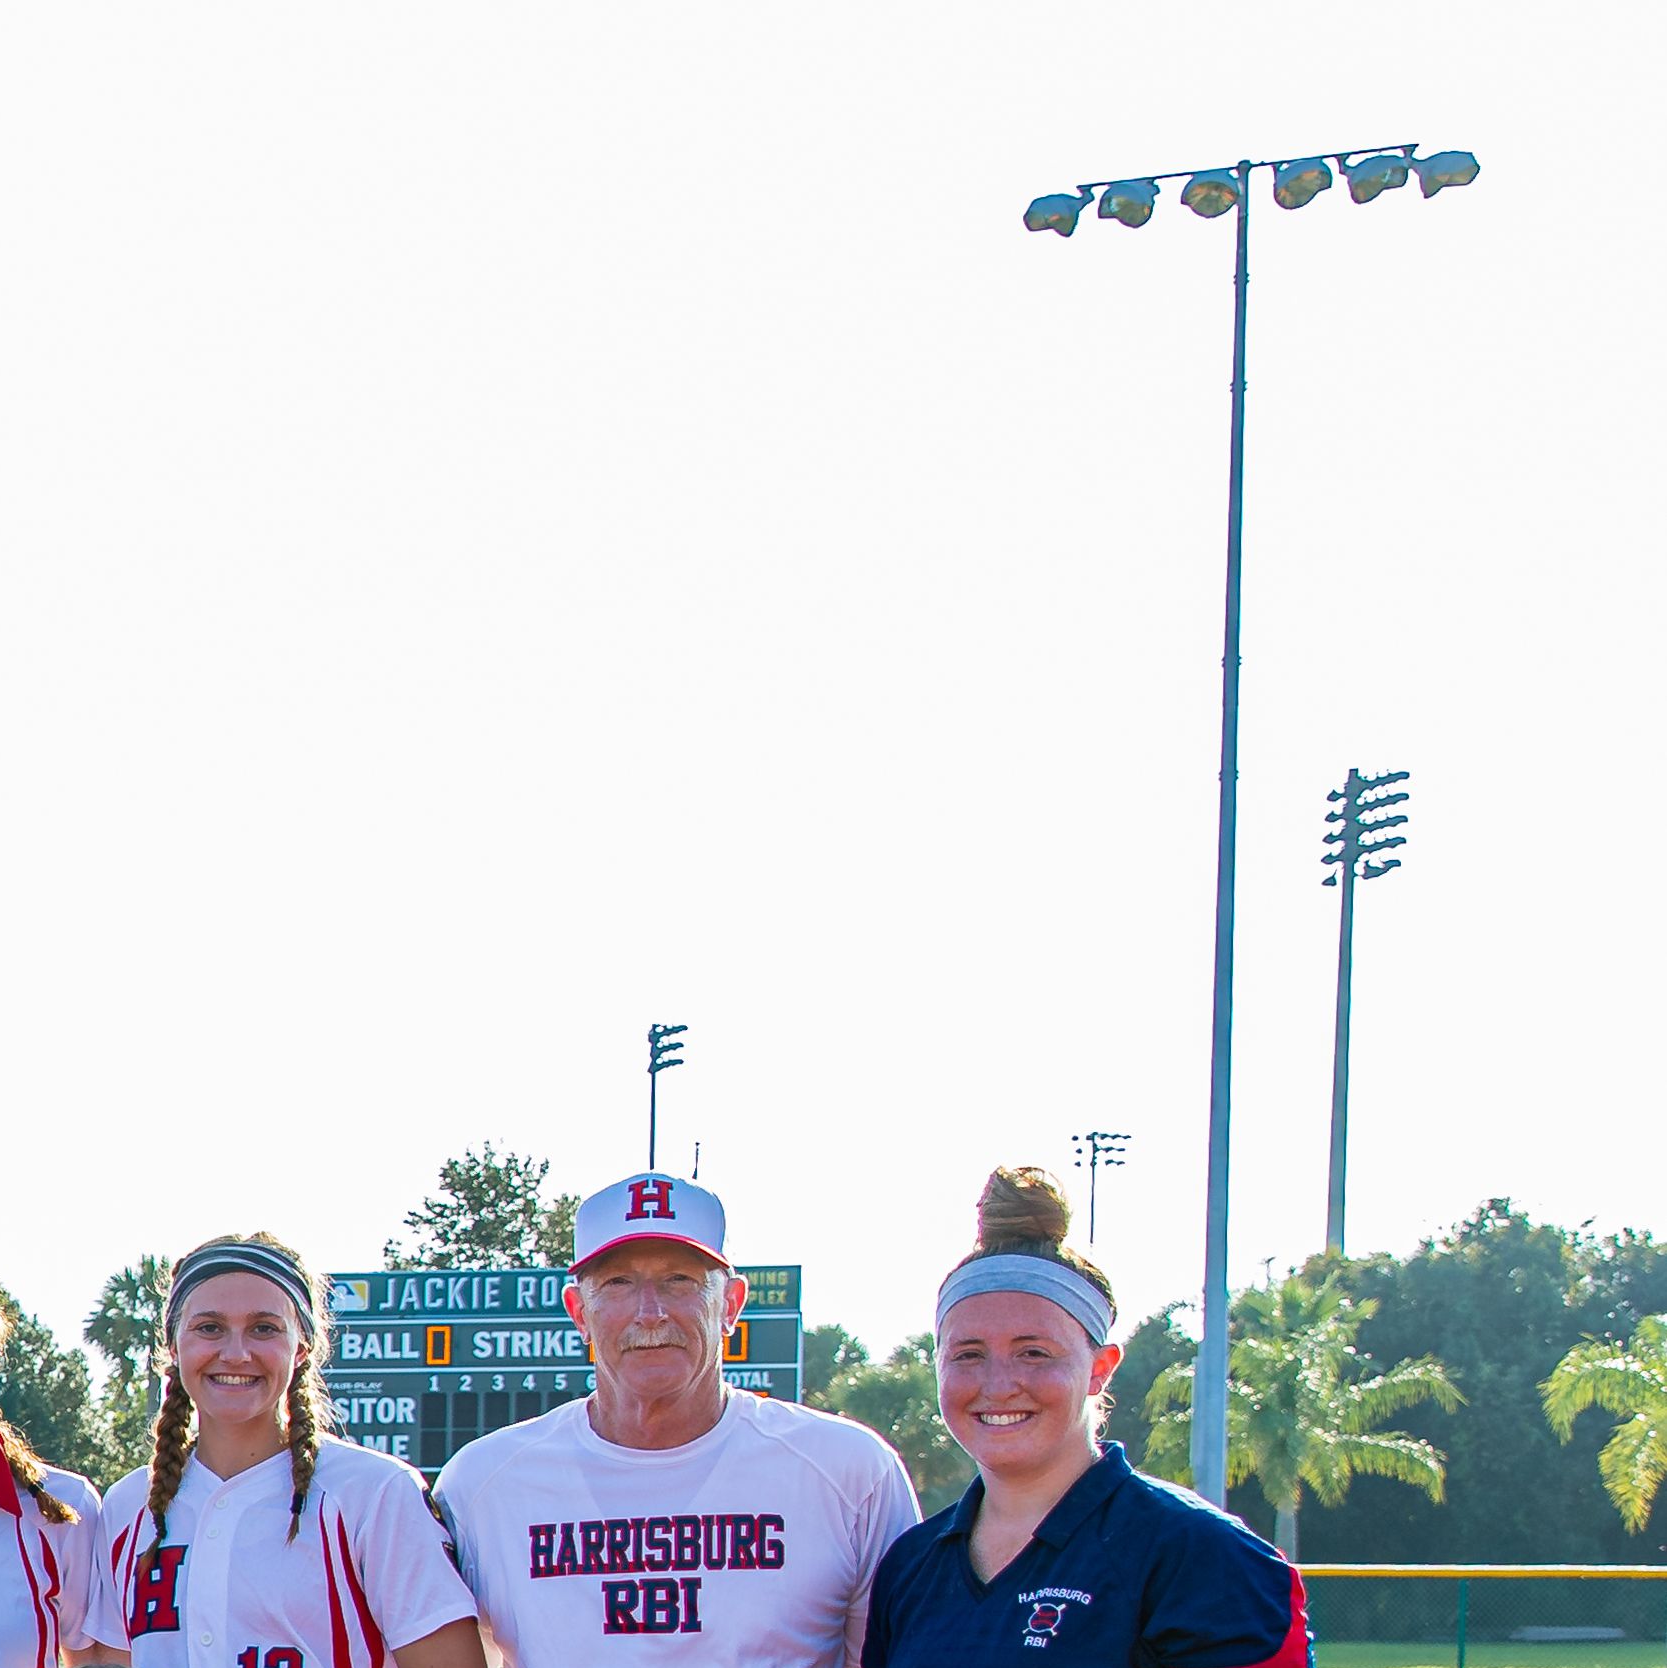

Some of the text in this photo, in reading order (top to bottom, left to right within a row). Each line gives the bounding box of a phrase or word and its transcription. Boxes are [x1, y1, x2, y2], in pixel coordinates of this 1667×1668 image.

[625, 1179, 676, 1220] H
[378, 1274, 501, 1311] JACKIE
[744, 1271, 789, 1286] NING
[748, 1289, 788, 1304] PLEX
[341, 1331, 419, 1360] BALL
[473, 1329, 584, 1359] STRIKE
[429, 1376, 440, 1392] 1
[459, 1375, 472, 1391] 2
[492, 1375, 505, 1391] 3
[522, 1374, 537, 1390] 4
[555, 1374, 568, 1390] 5
[332, 1397, 415, 1425] SITOR
[529, 1514, 785, 1579] HARRISBURG
[128, 1544, 189, 1639] H
[1018, 1587, 1092, 1605] HARRISBURG
[601, 1578, 704, 1635] RBI
[1024, 1635, 1048, 1648] RBI
